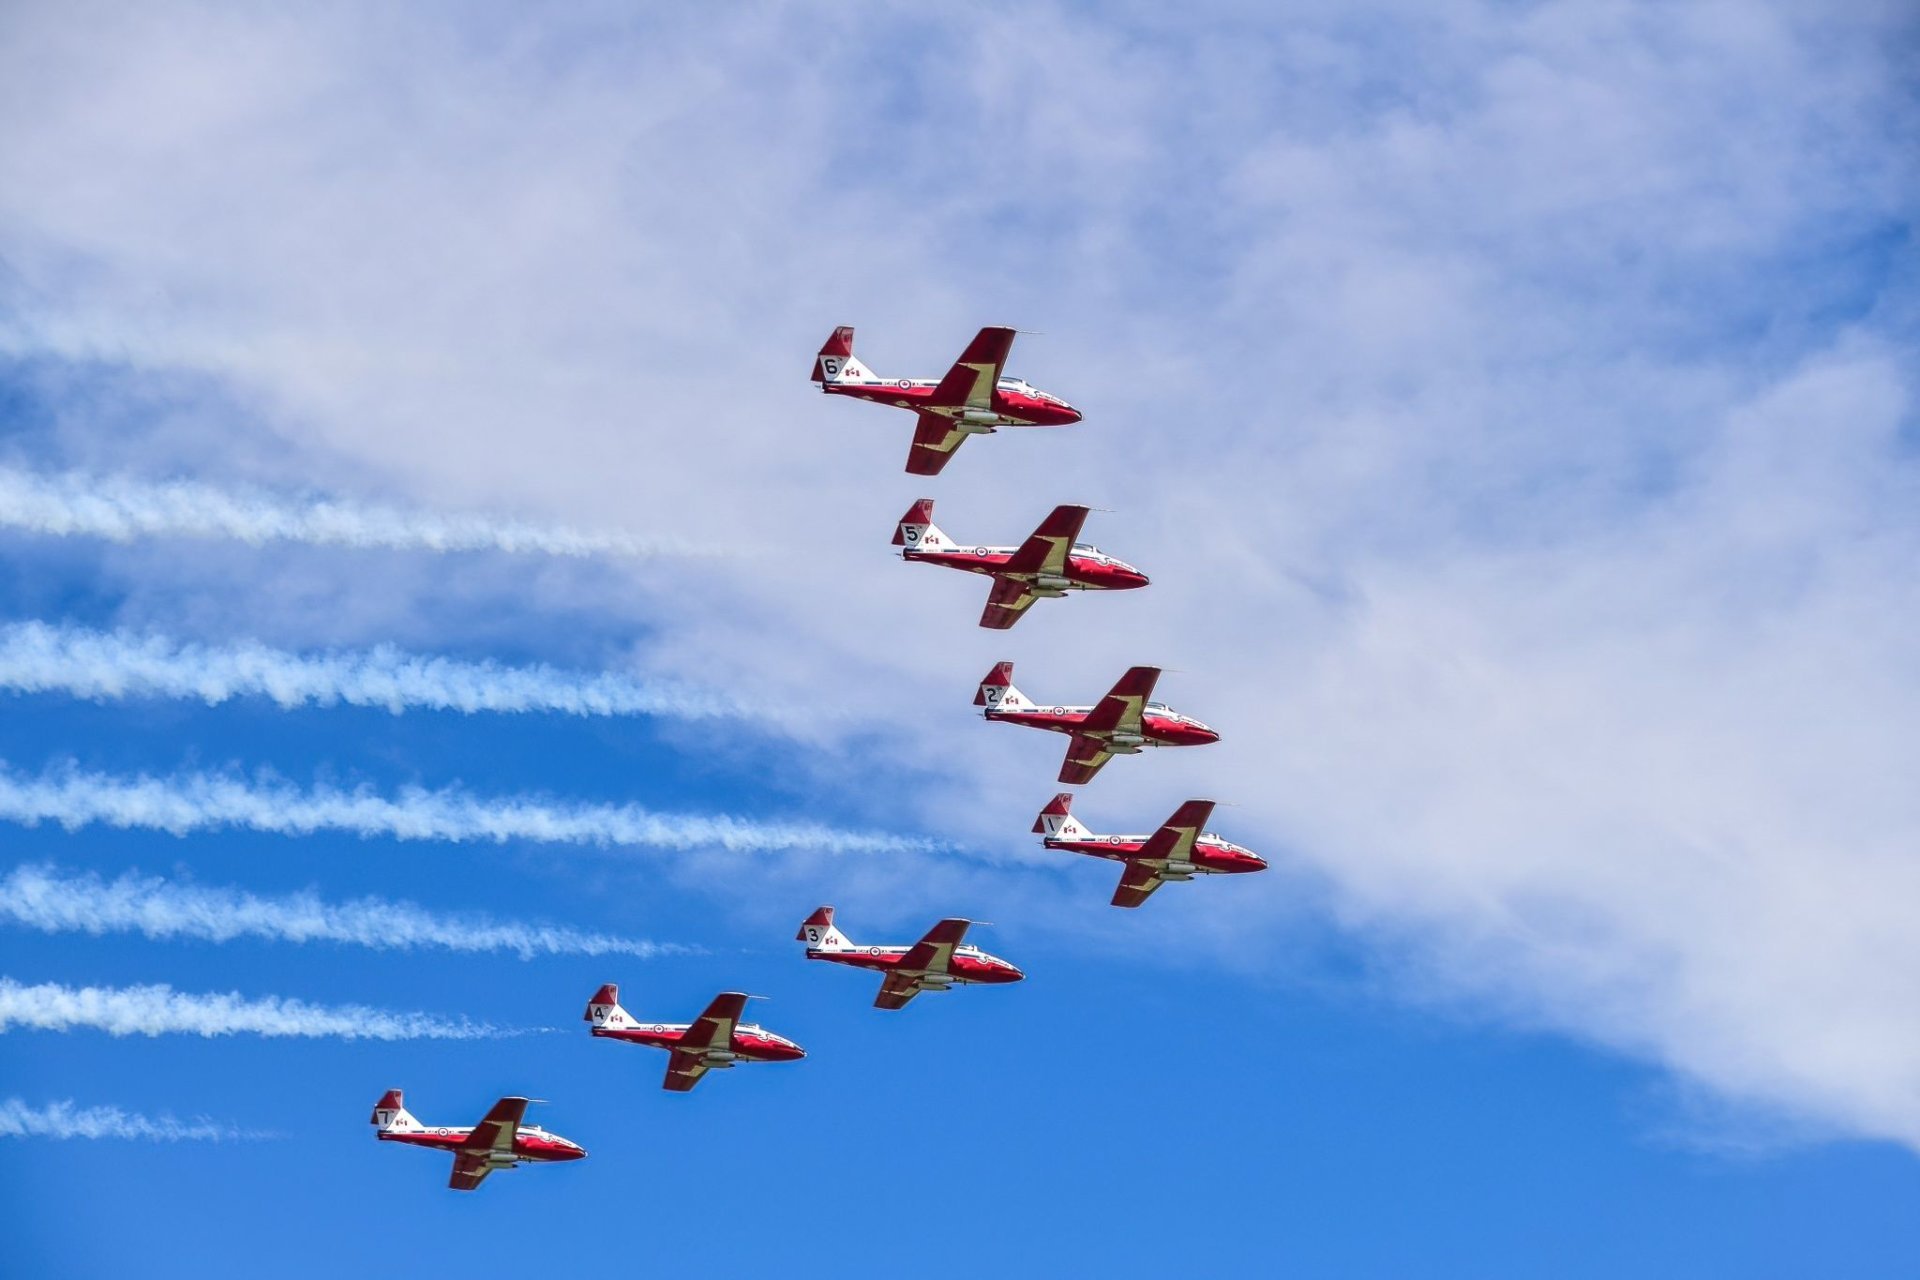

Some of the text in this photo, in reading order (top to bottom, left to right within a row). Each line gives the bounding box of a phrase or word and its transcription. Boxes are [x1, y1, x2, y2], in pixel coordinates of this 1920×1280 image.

[824, 359, 838, 374] 6
[905, 526, 918, 541] 5
[986, 688, 998, 702] 2
[1048, 818, 1054, 831] 1
[808, 928, 819, 942] 3
[594, 1007, 604, 1020] 4
[378, 1111, 389, 1124] 7
